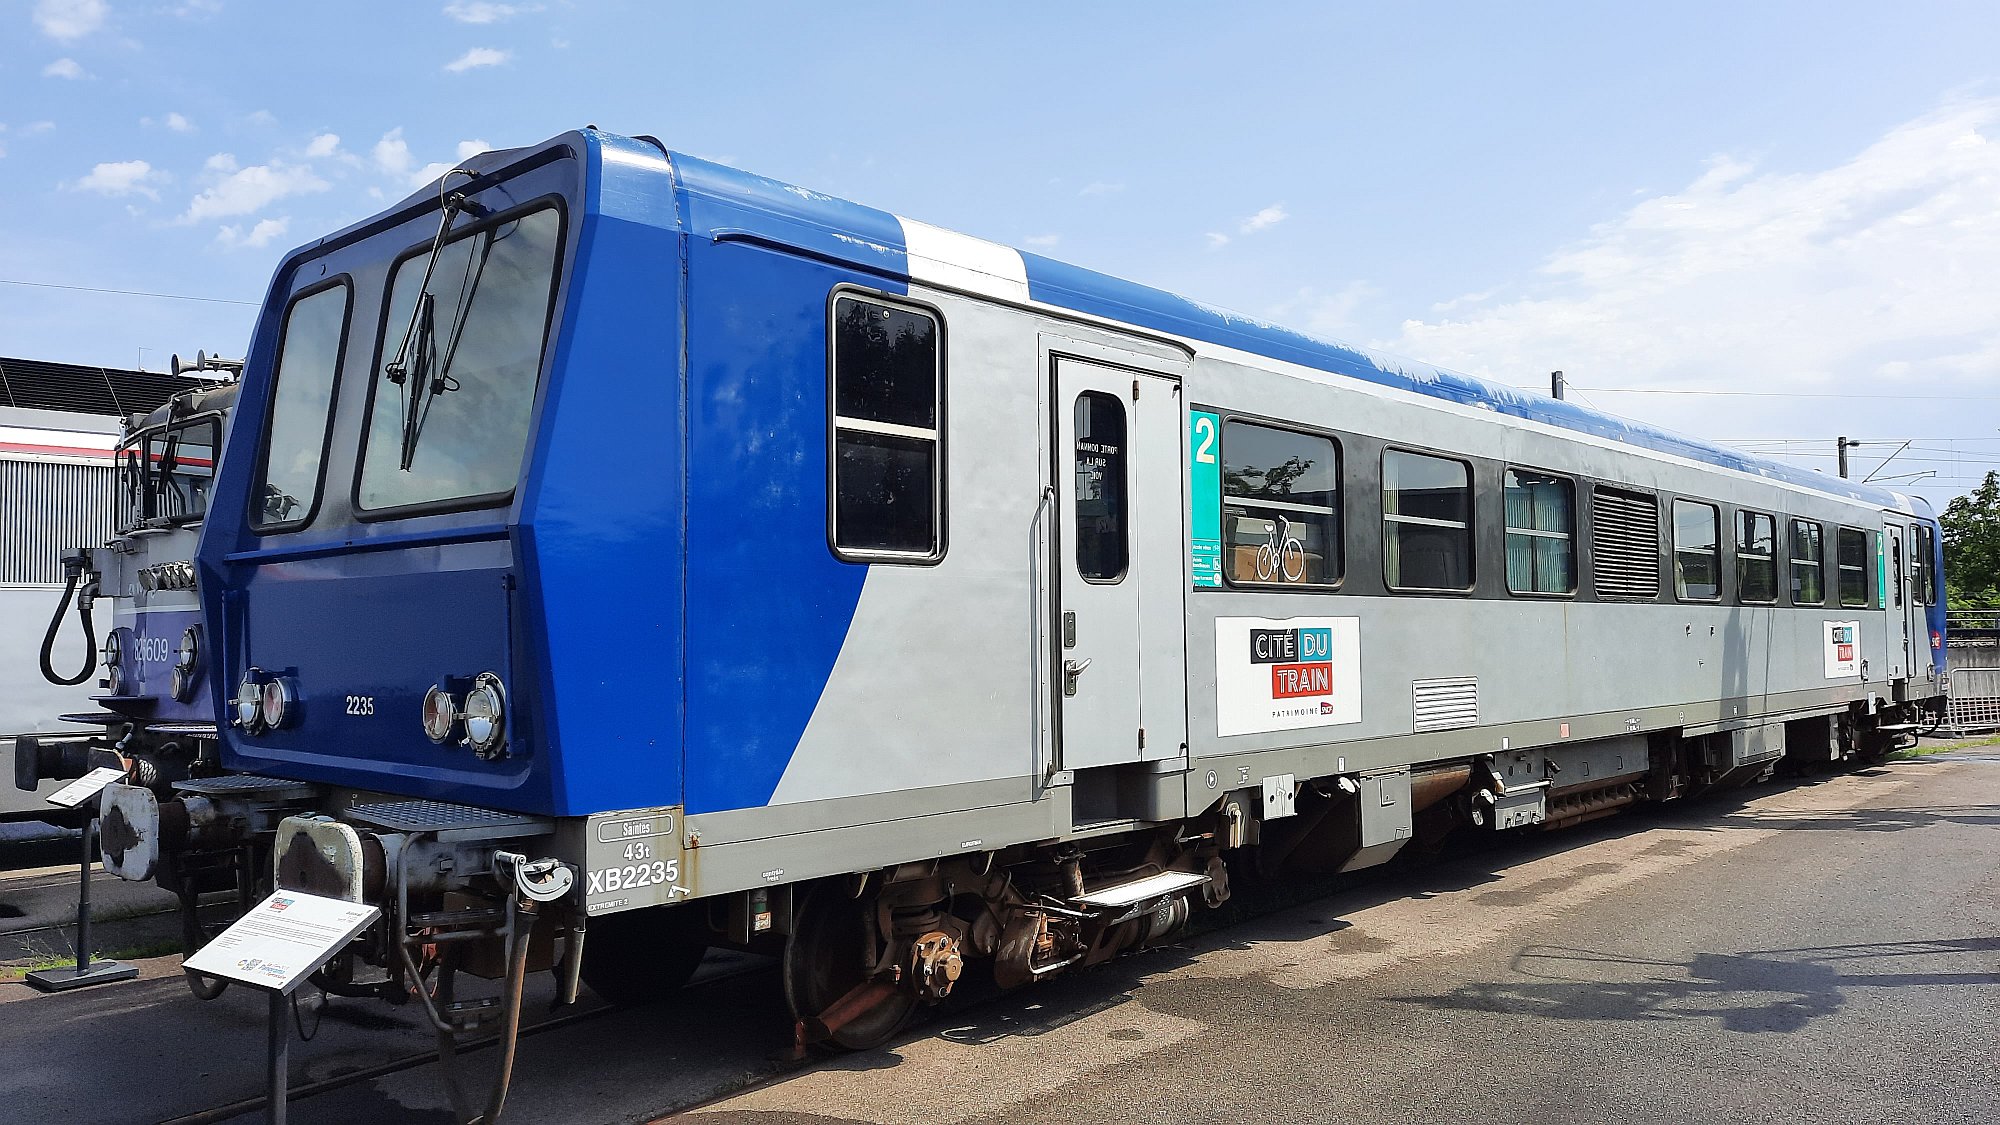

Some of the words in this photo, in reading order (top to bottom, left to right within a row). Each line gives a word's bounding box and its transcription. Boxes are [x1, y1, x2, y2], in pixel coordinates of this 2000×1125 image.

[1195, 417, 1215, 464] 2
[1255, 629, 1294, 659] CITÉ
[1303, 633, 1328, 657] DU
[1277, 667, 1328, 693] TRAIN
[346, 695, 374, 716] 2235
[1271, 707, 1318, 718] PATRIMOINE
[622, 821, 650, 837] Saintes
[623, 842, 650, 861] 43t
[586, 860, 678, 896] XB2235
